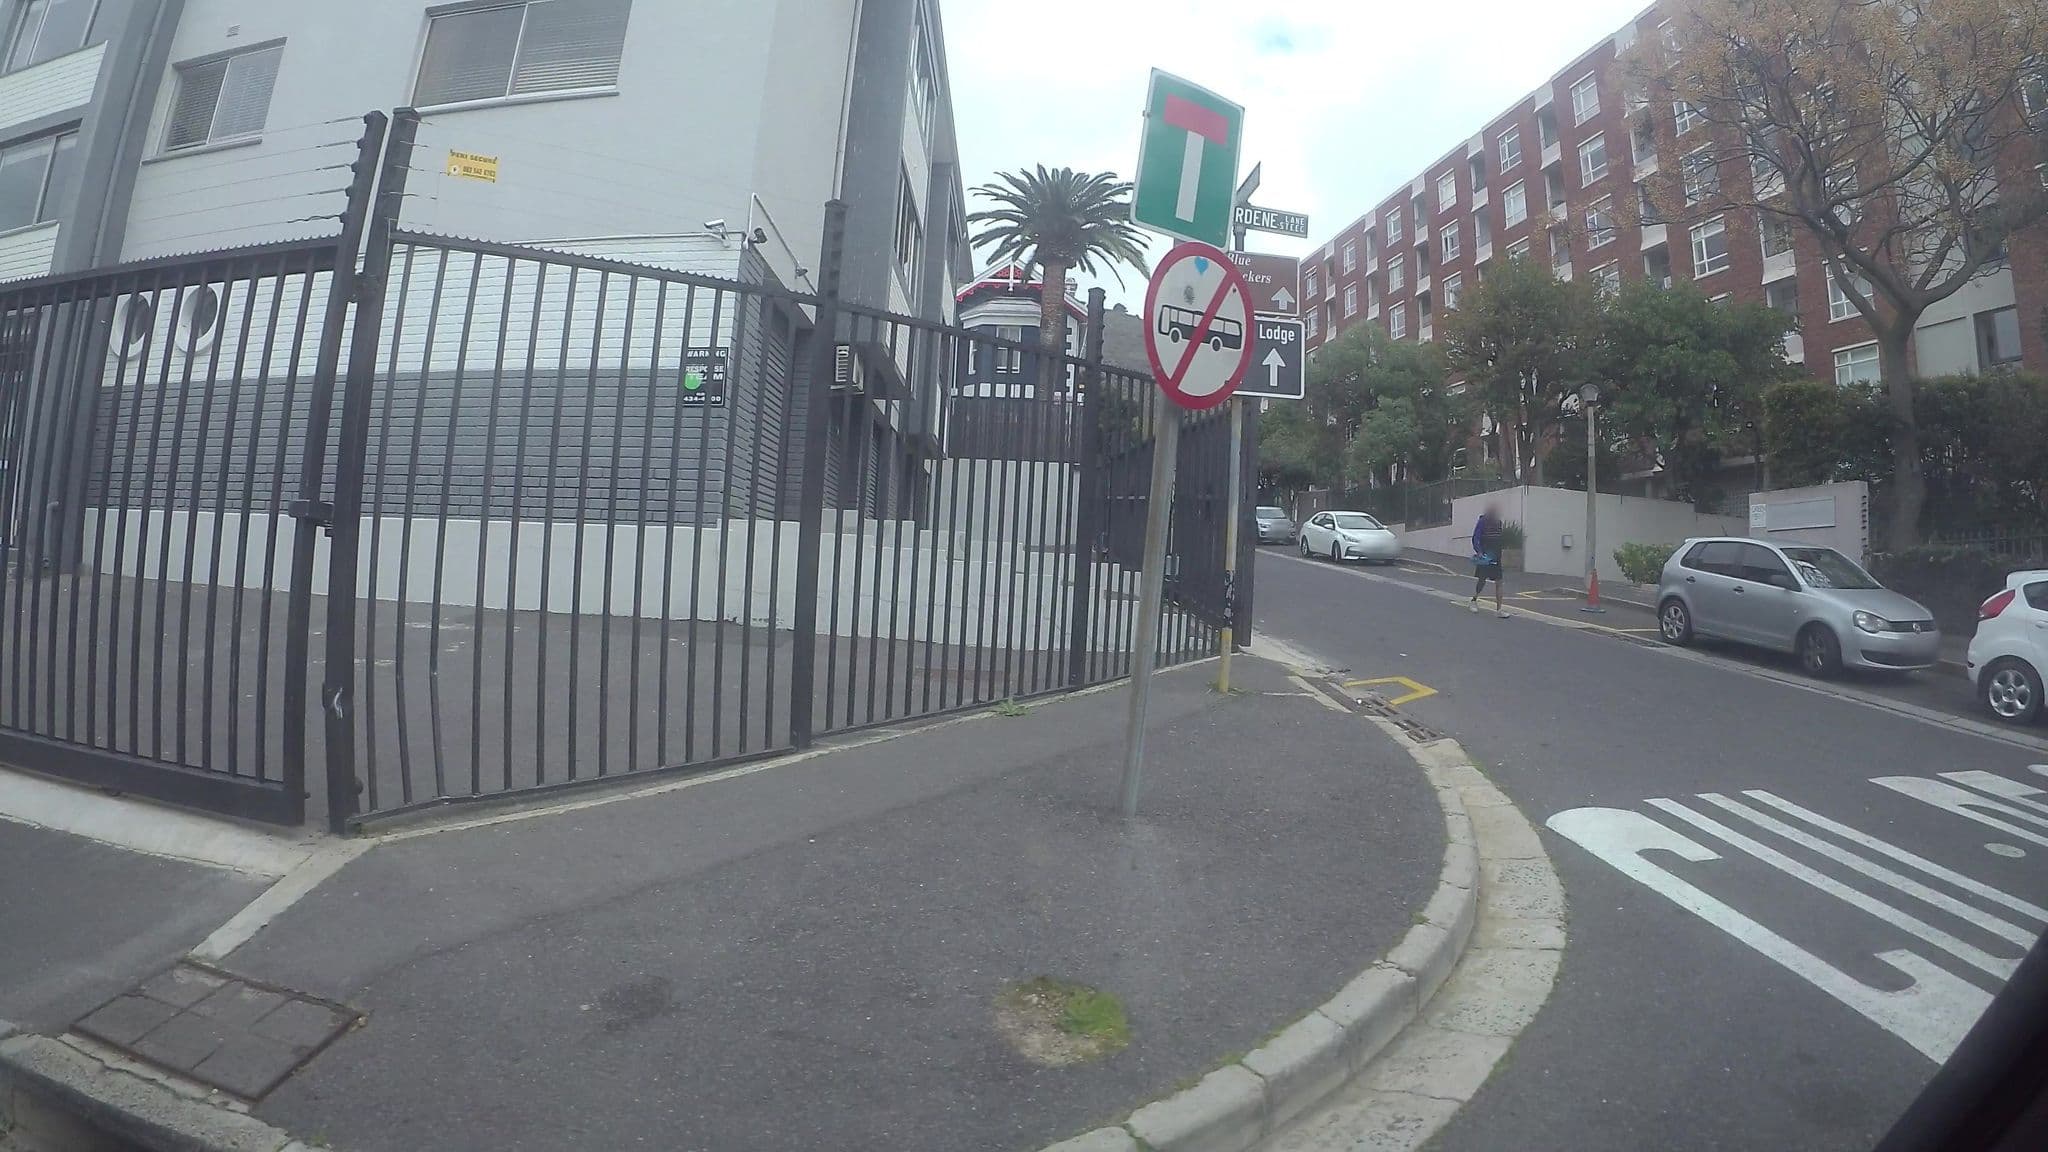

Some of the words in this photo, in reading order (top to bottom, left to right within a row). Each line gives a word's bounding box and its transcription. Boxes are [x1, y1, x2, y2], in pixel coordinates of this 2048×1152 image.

[1235, 207, 1279, 229] RDENE
[1285, 215, 1305, 226] LANE
[1242, 270, 1272, 284] ckers
[1259, 323, 1295, 345] Lodge
[687, 350, 726, 358] WARNNG
